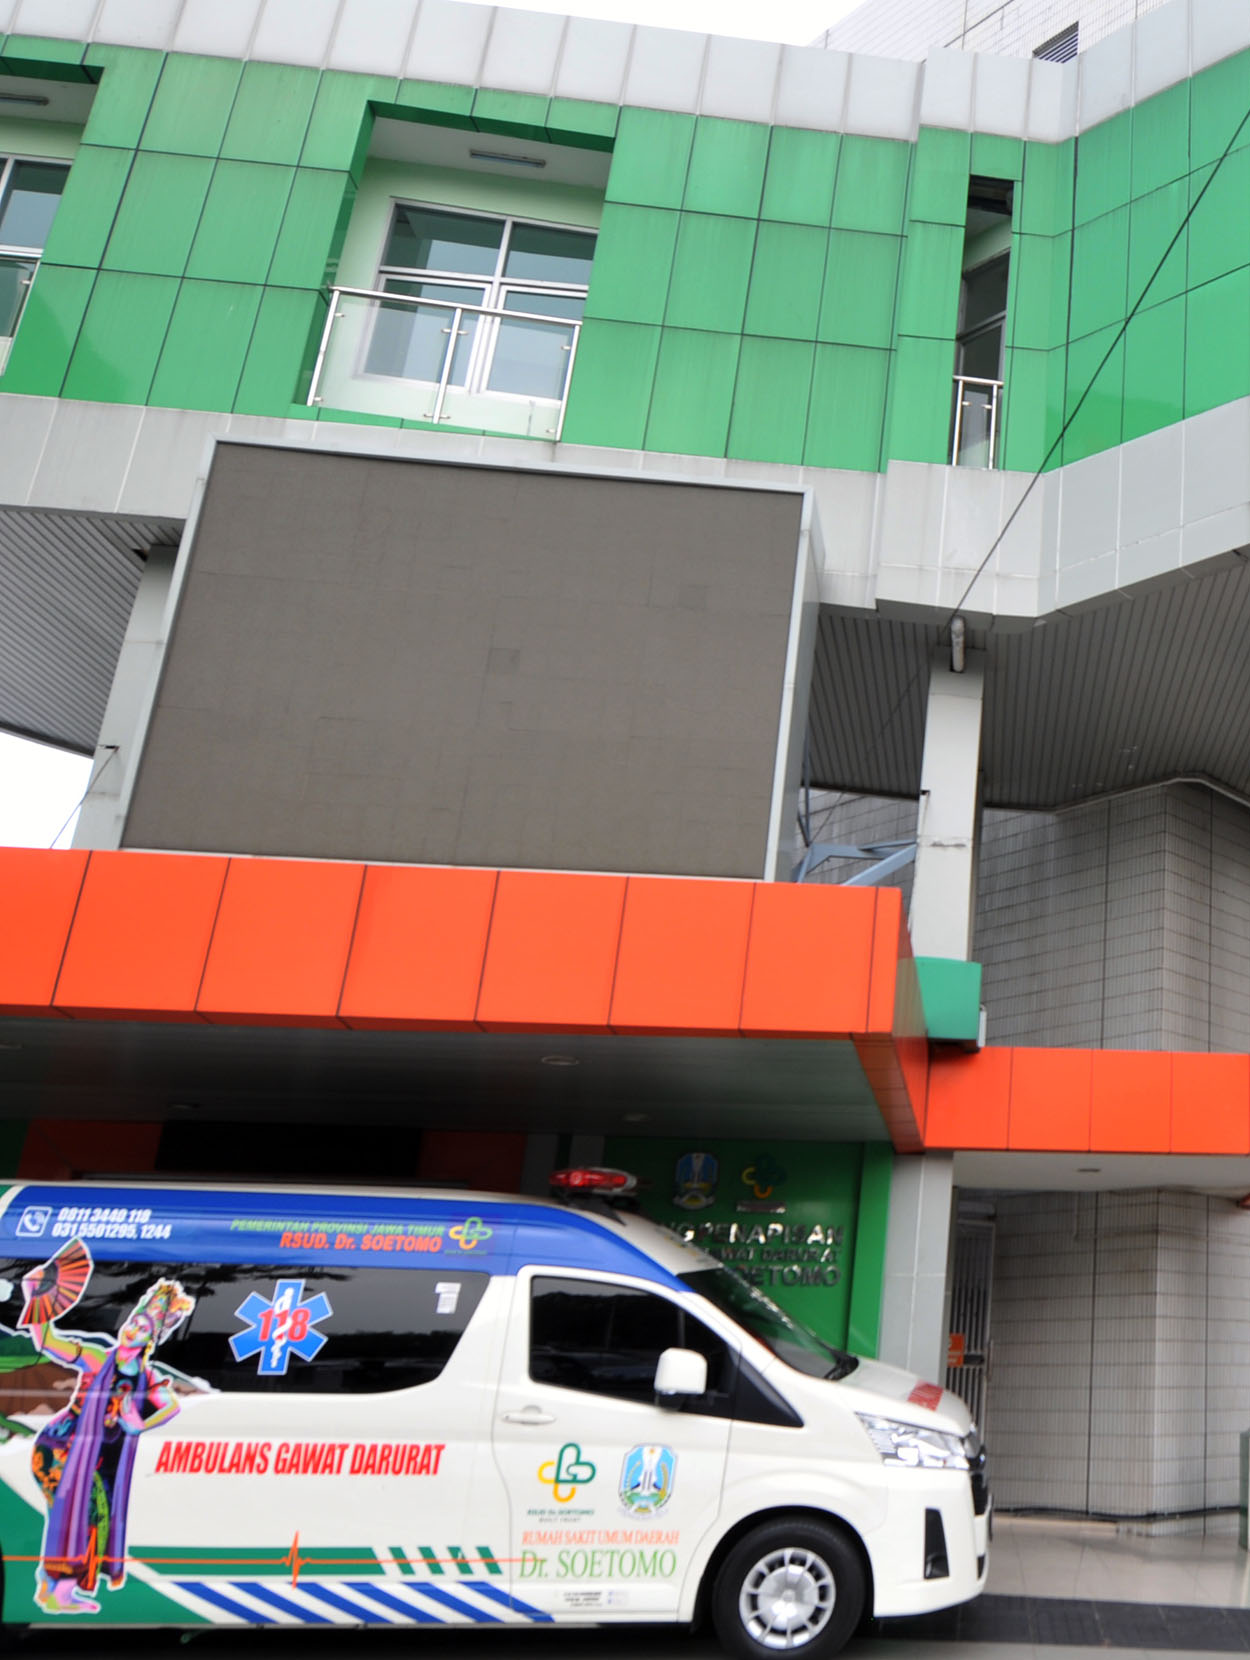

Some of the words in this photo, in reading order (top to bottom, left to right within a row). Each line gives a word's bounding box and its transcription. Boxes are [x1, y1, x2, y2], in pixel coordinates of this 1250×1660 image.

[140, 1224, 172, 1239] 1244
[230, 1219, 309, 1233] PEMERINTAH
[310, 1220, 369, 1234] PROVINSI
[370, 1222, 403, 1236] JAWA
[407, 1224, 445, 1237] TIMUR
[279, 1232, 329, 1249] RSUD.
[334, 1233, 356, 1249] Dr.
[361, 1234, 442, 1252] SOETOMO
[258, 1307, 311, 1342] 118
[155, 1441, 272, 1475] AMBULANS
[273, 1443, 349, 1475] GAWAT
[349, 1443, 445, 1476] DARURAT
[521, 1529, 563, 1545] RUMAH
[563, 1530, 597, 1545] SAKIT
[597, 1530, 635, 1545] UMUM
[635, 1530, 680, 1545] DAERAH
[519, 1549, 549, 1578] Dr.
[556, 1549, 677, 1579] SOETOMO
